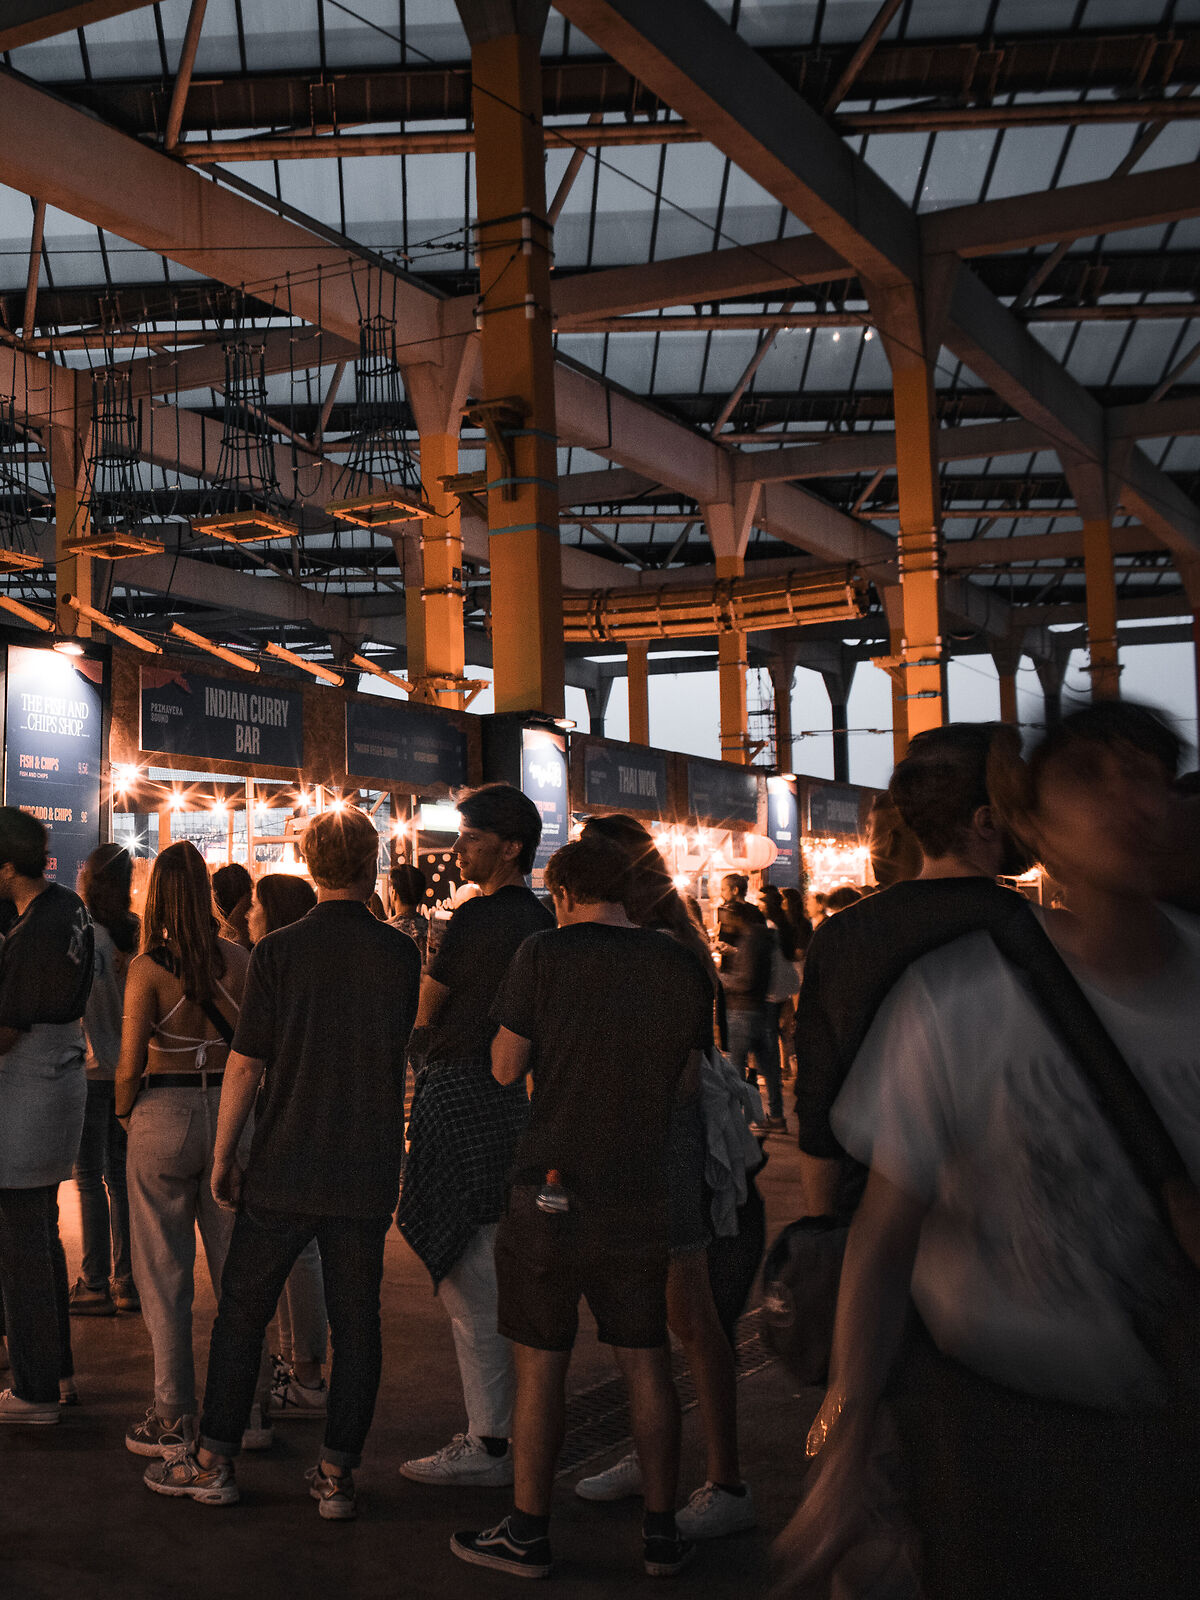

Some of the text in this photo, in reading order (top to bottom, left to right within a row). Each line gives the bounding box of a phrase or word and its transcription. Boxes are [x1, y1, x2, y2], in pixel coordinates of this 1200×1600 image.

[20, 693, 89, 720] THE FISH AND
[150, 702, 184, 716] PRIMAVERA
[150, 712, 169, 723] SOUND
[205, 686, 289, 728] INDIAN CURRY
[27, 712, 84, 737] CHIPS SHOP
[235, 724, 261, 755] BAR
[19, 754, 59, 771] FISH & CHIPS
[618, 766, 637, 795] THAI
[638, 769, 657, 797] WOK
[49, 807, 54, 821] &
[54, 807, 72, 822] CHIPS
